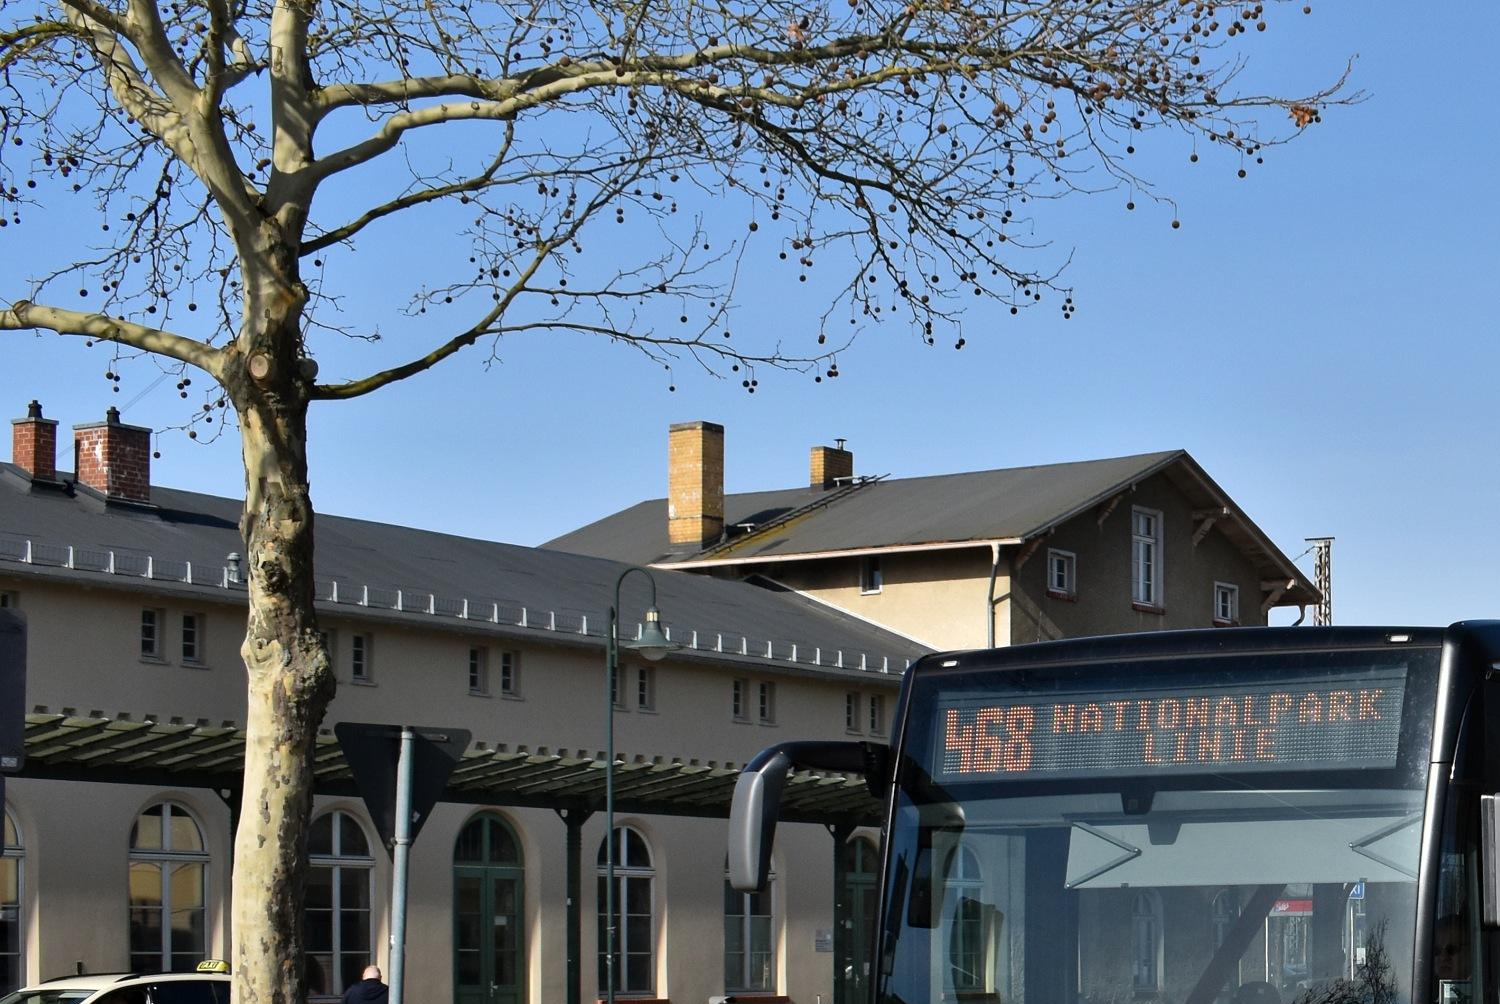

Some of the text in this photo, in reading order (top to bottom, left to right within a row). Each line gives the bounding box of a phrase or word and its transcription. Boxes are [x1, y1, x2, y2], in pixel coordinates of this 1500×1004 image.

[943, 688, 1385, 774] 468 NATIONALPARK
[1142, 728, 1277, 765] LINIE
